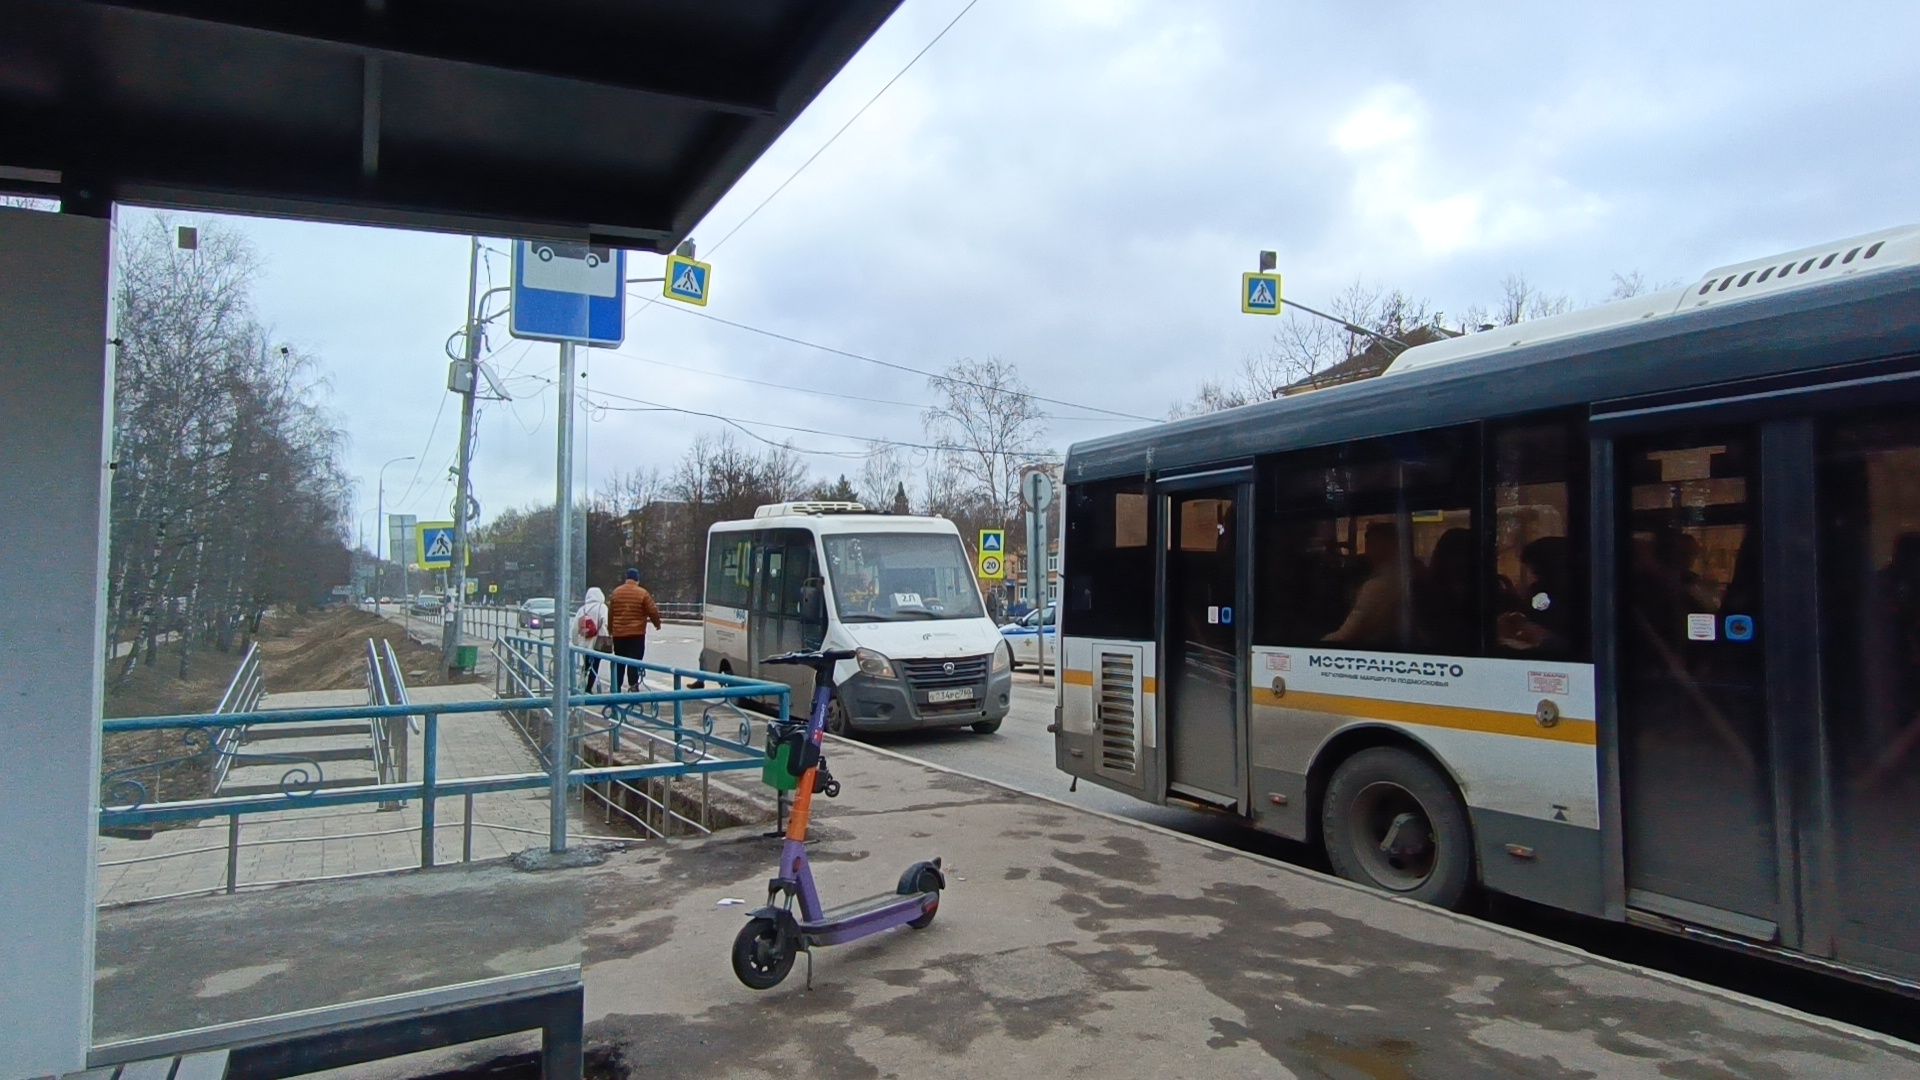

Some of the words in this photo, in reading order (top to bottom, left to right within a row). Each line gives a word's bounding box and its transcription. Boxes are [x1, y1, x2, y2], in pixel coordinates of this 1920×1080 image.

[986, 561, 997, 570] 20
[1308, 654, 1464, 678] МОСТРАНСАВТО
[1397, 677, 1450, 688] ПОДМОСКОВЬЯ
